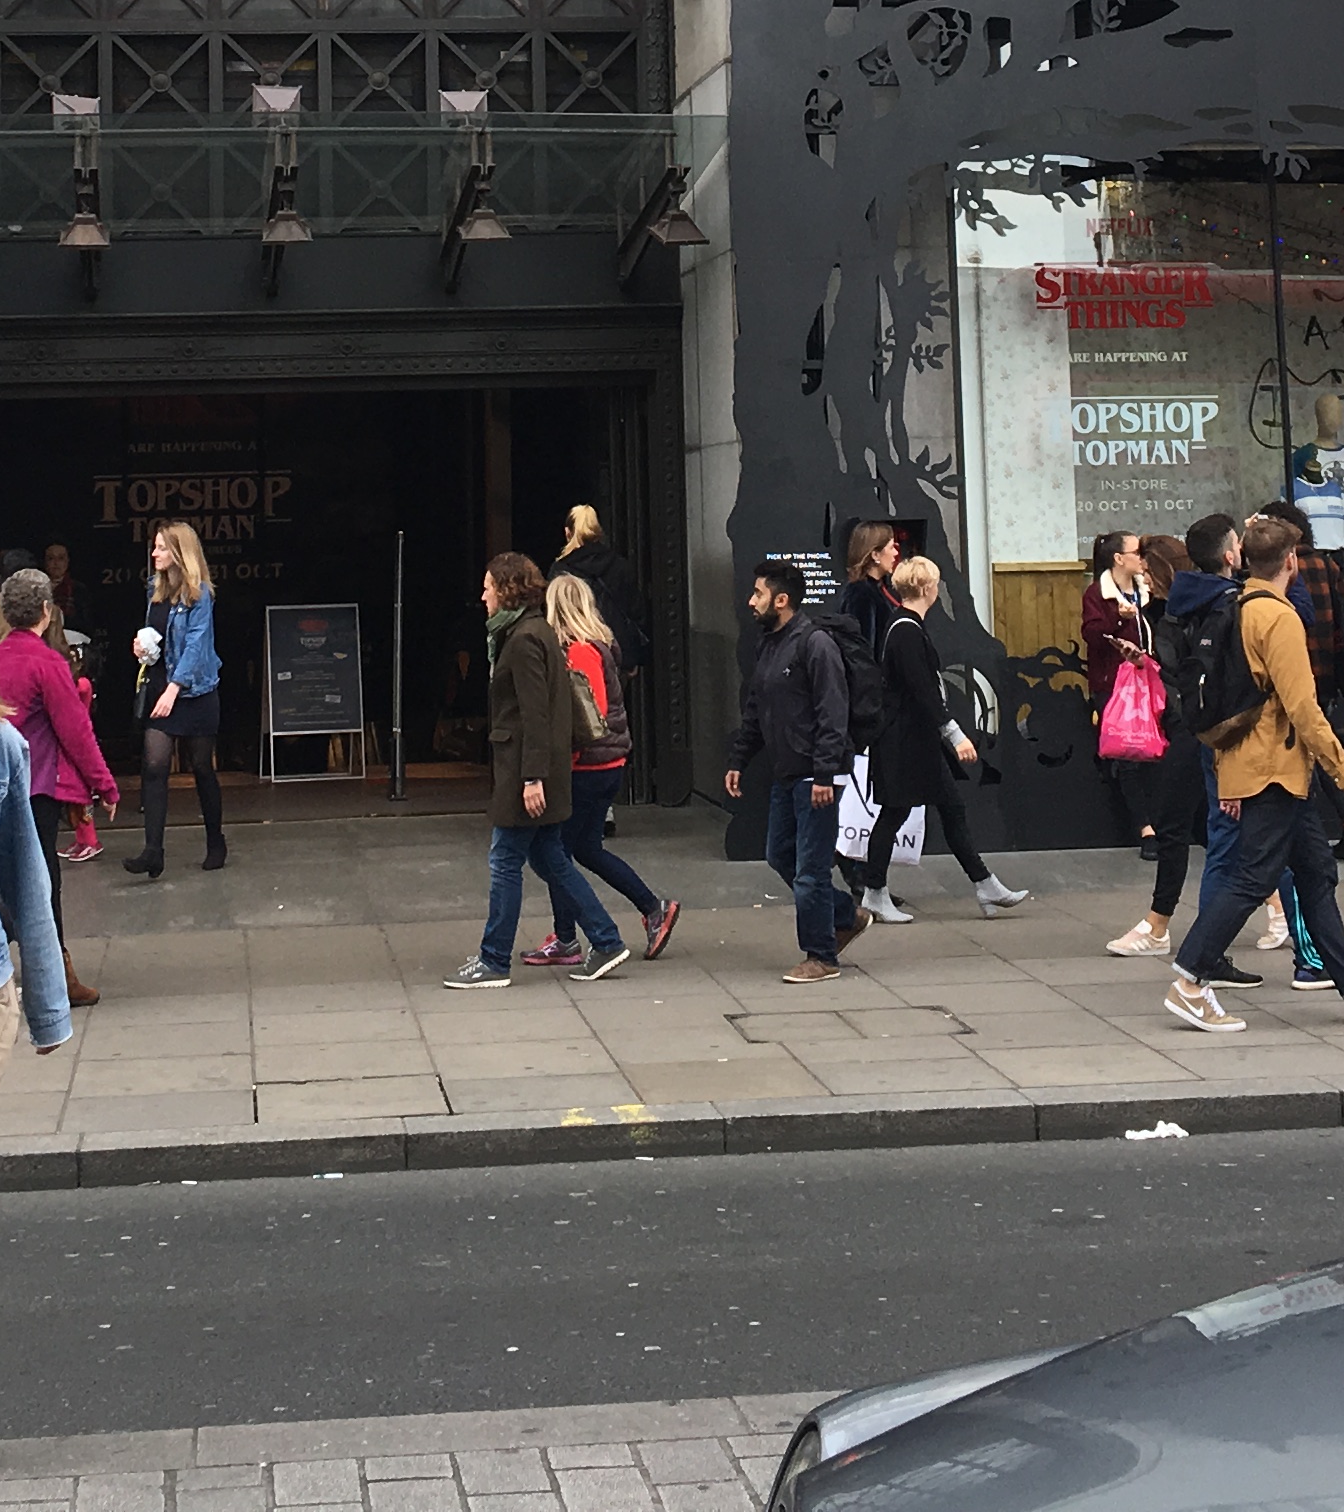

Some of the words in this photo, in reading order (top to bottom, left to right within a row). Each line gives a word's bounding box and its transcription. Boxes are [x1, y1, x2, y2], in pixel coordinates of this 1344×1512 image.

[1086, 216, 1154, 237] NETFLIX
[1034, 266, 1214, 304] STRANGER
[1064, 299, 1187, 329] THINGS
[1094, 351, 1167, 363] HAPPENING
[1171, 351, 1189, 362] AT
[1070, 401, 1219, 442] OPSHOP
[1072, 439, 1191, 467] TOPMAN
[1100, 478, 1169, 491] IN-STORE
[93, 476, 292, 522] TOPSHOP
[1076, 500, 1094, 512] 20
[1097, 500, 1129, 512] OCT
[1144, 500, 1160, 512] 31
[1165, 499, 1195, 511] OCT
